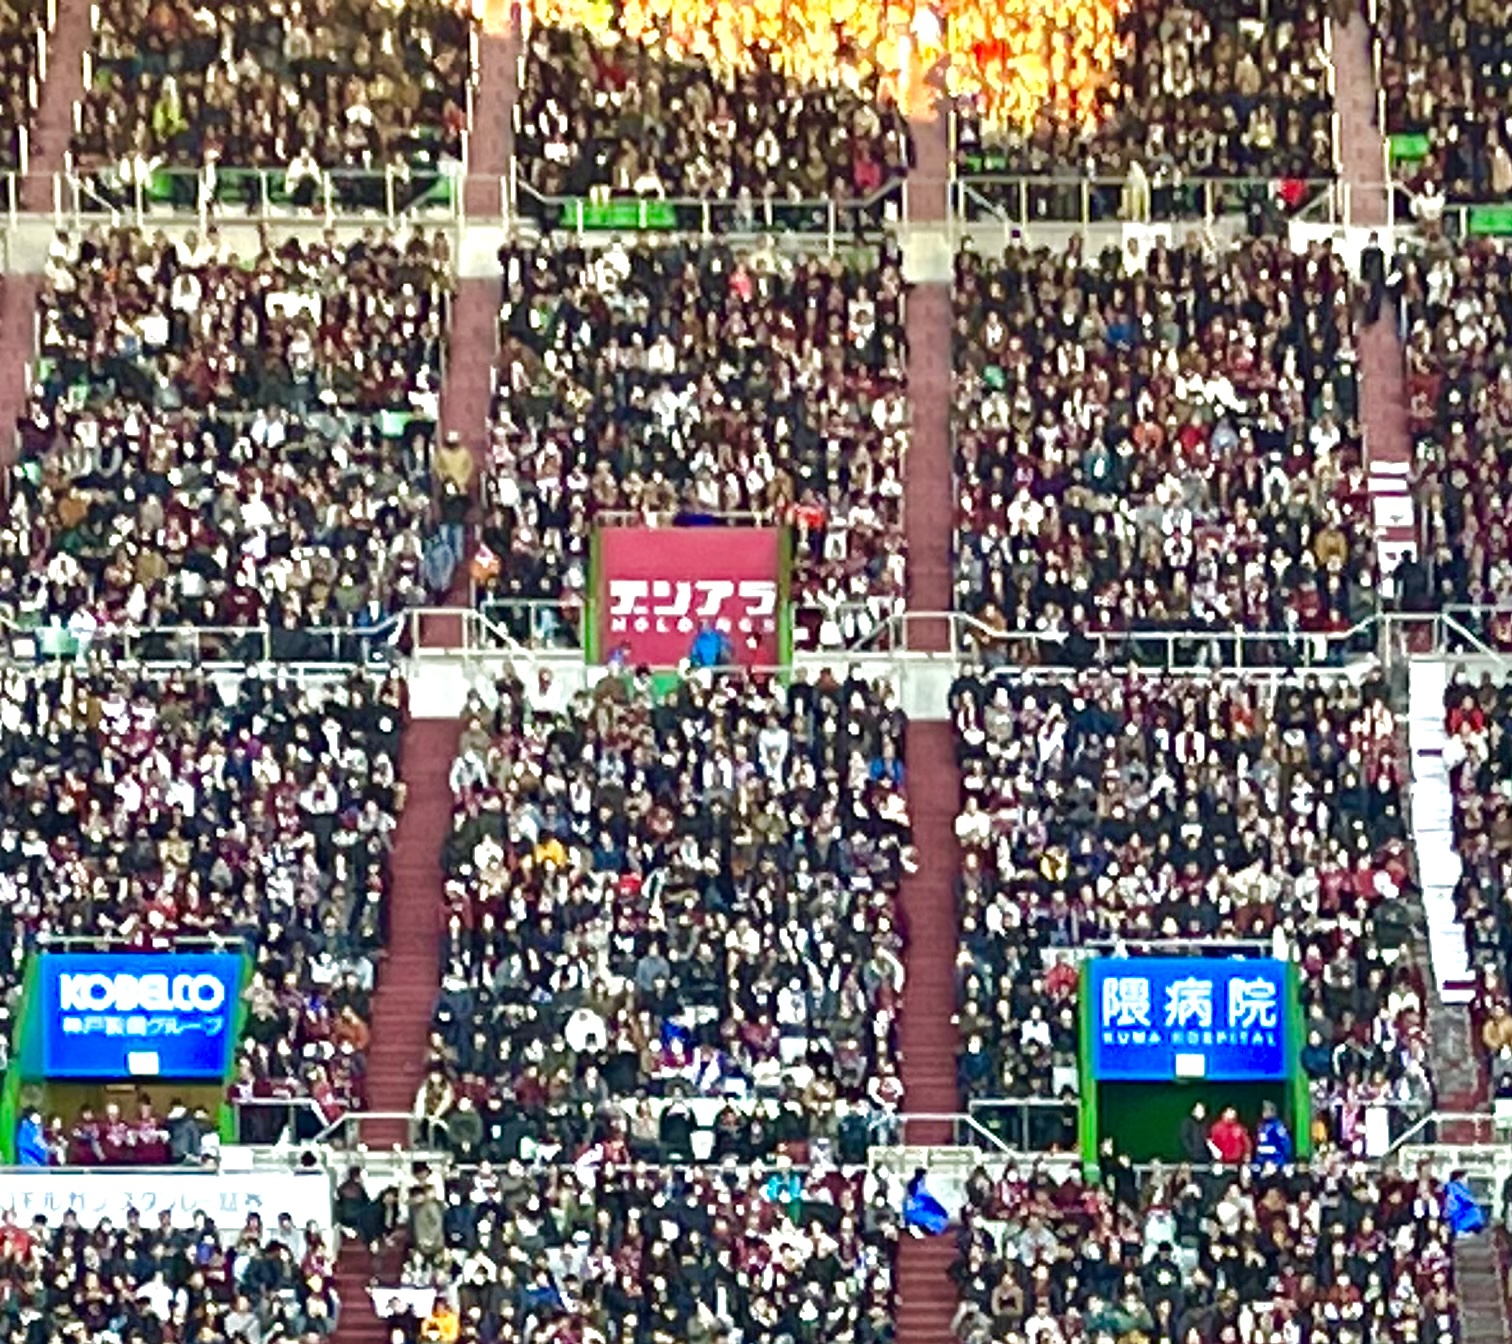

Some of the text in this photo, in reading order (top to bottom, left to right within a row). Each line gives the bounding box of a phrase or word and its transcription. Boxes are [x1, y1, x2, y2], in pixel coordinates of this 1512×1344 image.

[60, 974, 225, 1011] KOBELCO
[1102, 976, 1278, 1029] 隈病院
